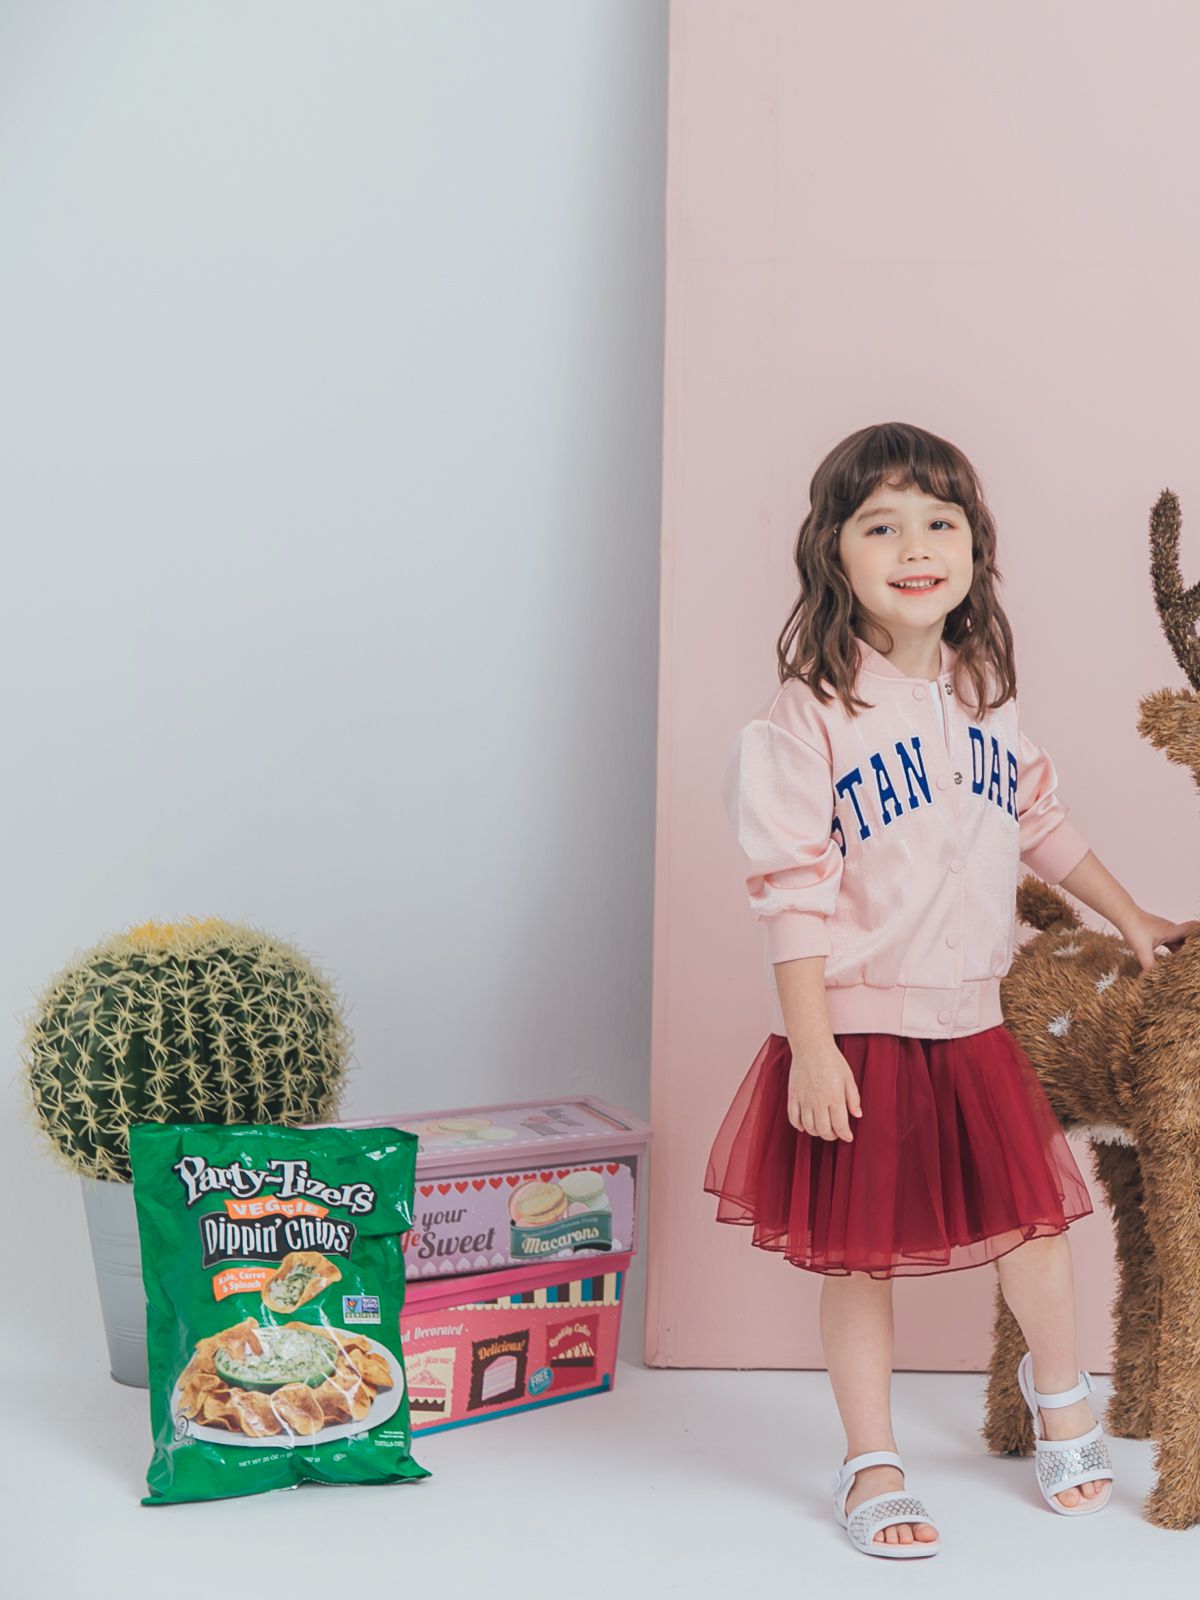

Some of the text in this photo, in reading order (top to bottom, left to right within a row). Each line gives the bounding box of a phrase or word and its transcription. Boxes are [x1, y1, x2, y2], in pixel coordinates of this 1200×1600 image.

[174, 1156, 374, 1213] Party-Tizers
[232, 1199, 320, 1216] VEGGIE
[421, 1209, 467, 1232] your
[205, 1217, 350, 1256] Dippin' Chips
[417, 1227, 496, 1259] Sweet
[521, 1227, 600, 1253] Macarons
[414, 1323, 464, 1340] Decorated
[478, 1339, 526, 1361] Delicious!
[530, 1368, 549, 1388] FREE
